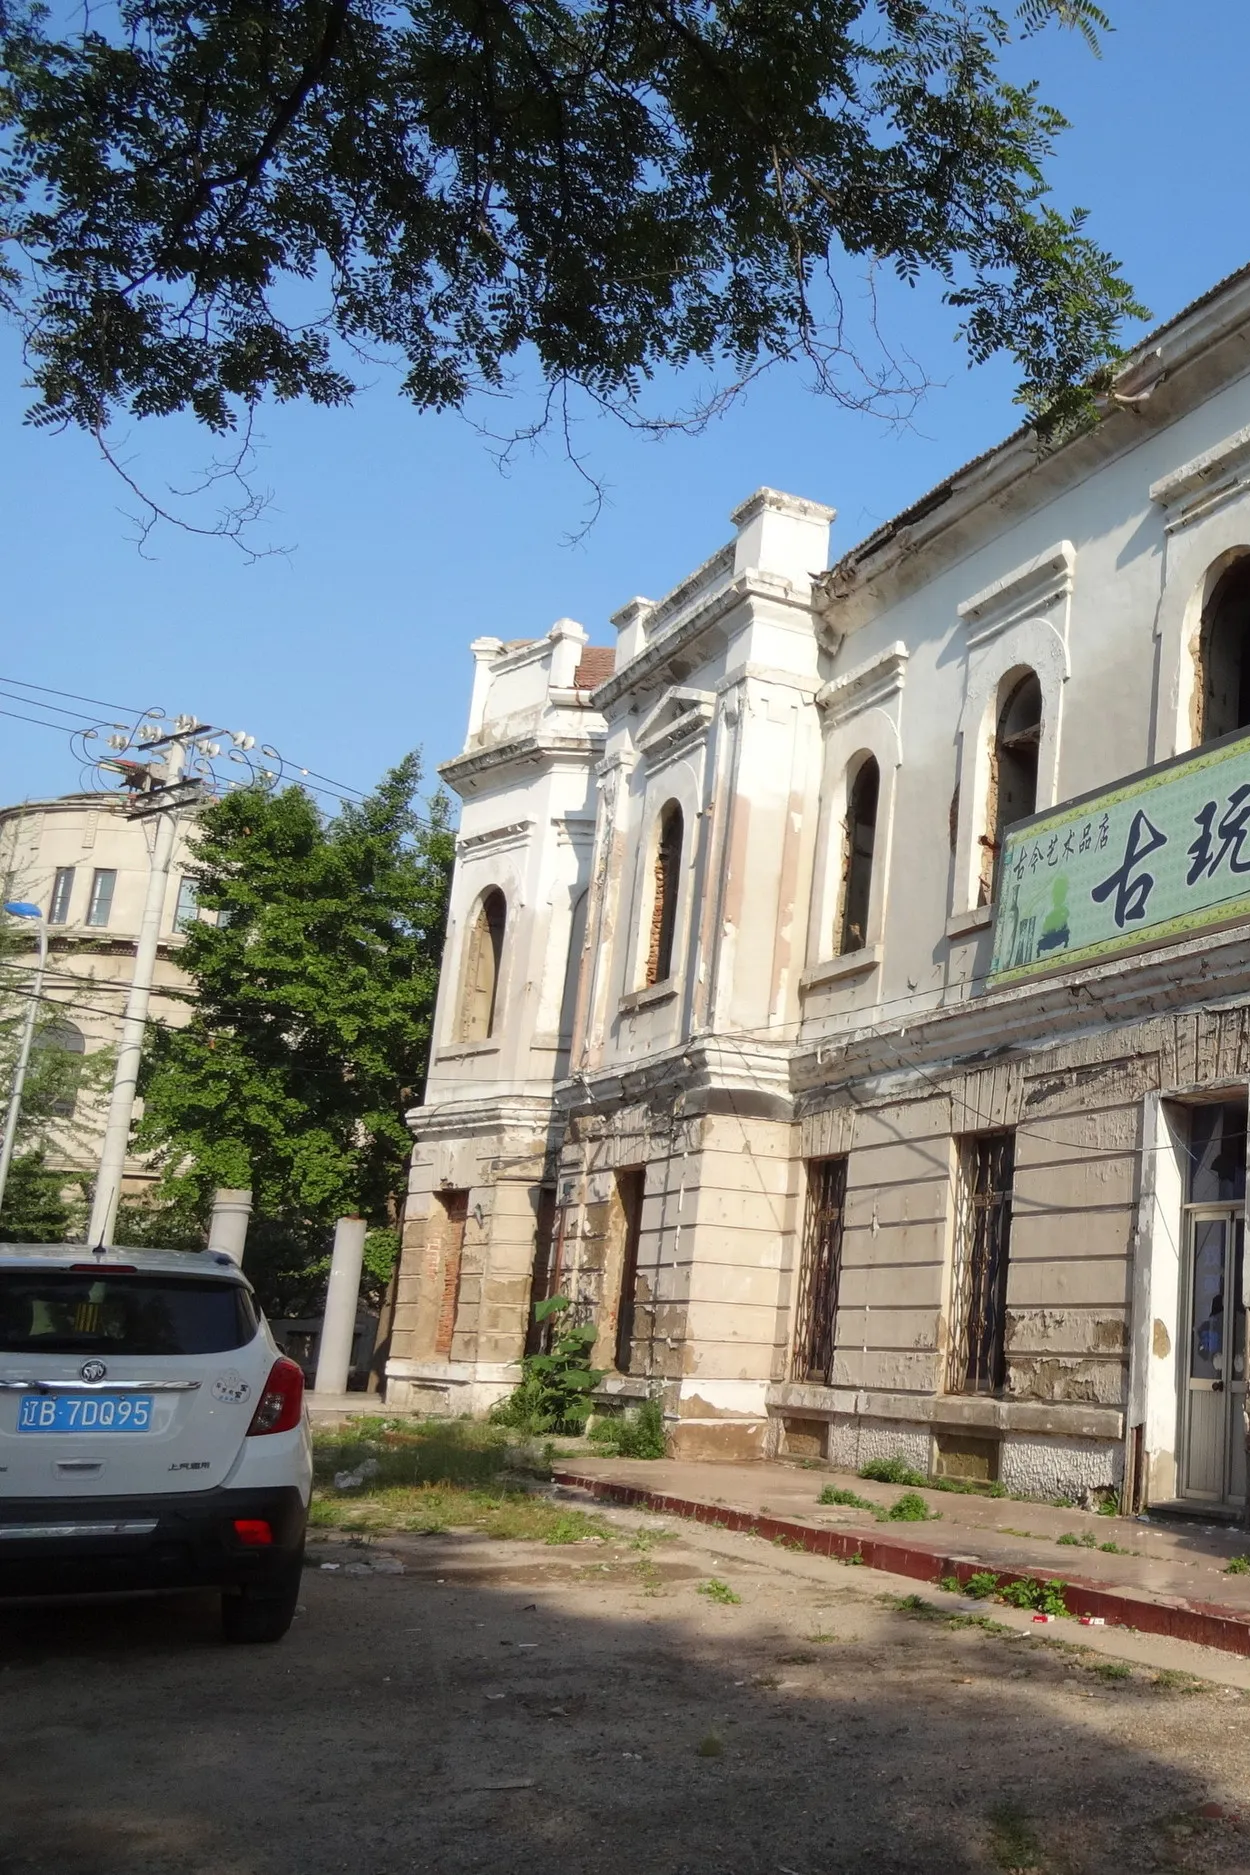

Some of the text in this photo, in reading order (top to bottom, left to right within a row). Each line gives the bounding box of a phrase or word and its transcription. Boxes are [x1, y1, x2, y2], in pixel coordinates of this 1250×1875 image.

[1012, 811, 1110, 881] 古今艺术品店
